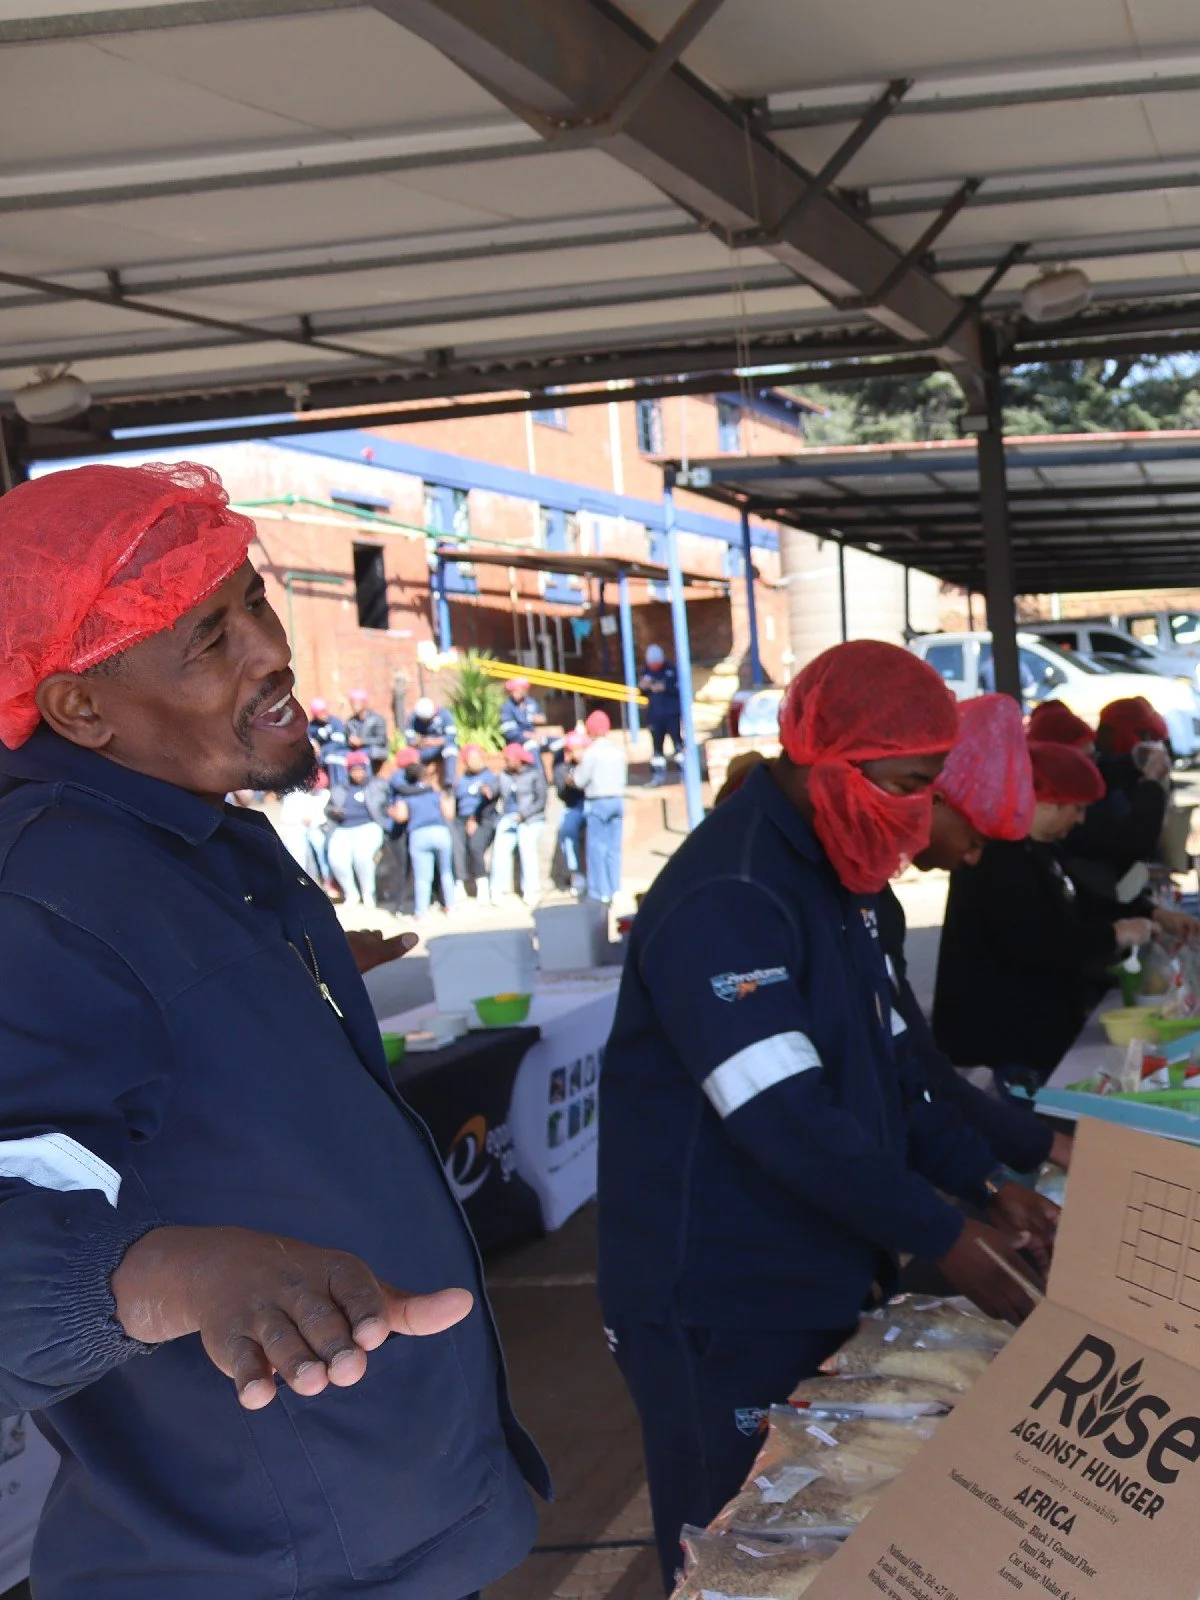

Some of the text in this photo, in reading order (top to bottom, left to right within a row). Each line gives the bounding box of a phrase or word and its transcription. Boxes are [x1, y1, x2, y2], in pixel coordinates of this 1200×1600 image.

[1009, 1417, 1165, 1520] AGAINST HUNGER
[1013, 1484, 1077, 1536] AFRICA
[1032, 1464, 1068, 1492] community
[1072, 1490, 1120, 1525] sustainability
[948, 1468, 971, 1490] National
[969, 1482, 987, 1500] Head
[984, 1493, 1003, 1511] Office
[1001, 1506, 1028, 1530] Address:
[1028, 1524, 1049, 1544] Block
[1052, 1541, 1081, 1568] Ground
[1077, 1557, 1098, 1578] Floor
[889, 1543, 912, 1567] National
[908, 1560, 926, 1580] Office
[1019, 1538, 1055, 1570] Omni Park
[998, 1566, 1024, 1590] Aeroton
[1020, 1561, 1042, 1582] Sailor
[1039, 1574, 1062, 1598] Malan
